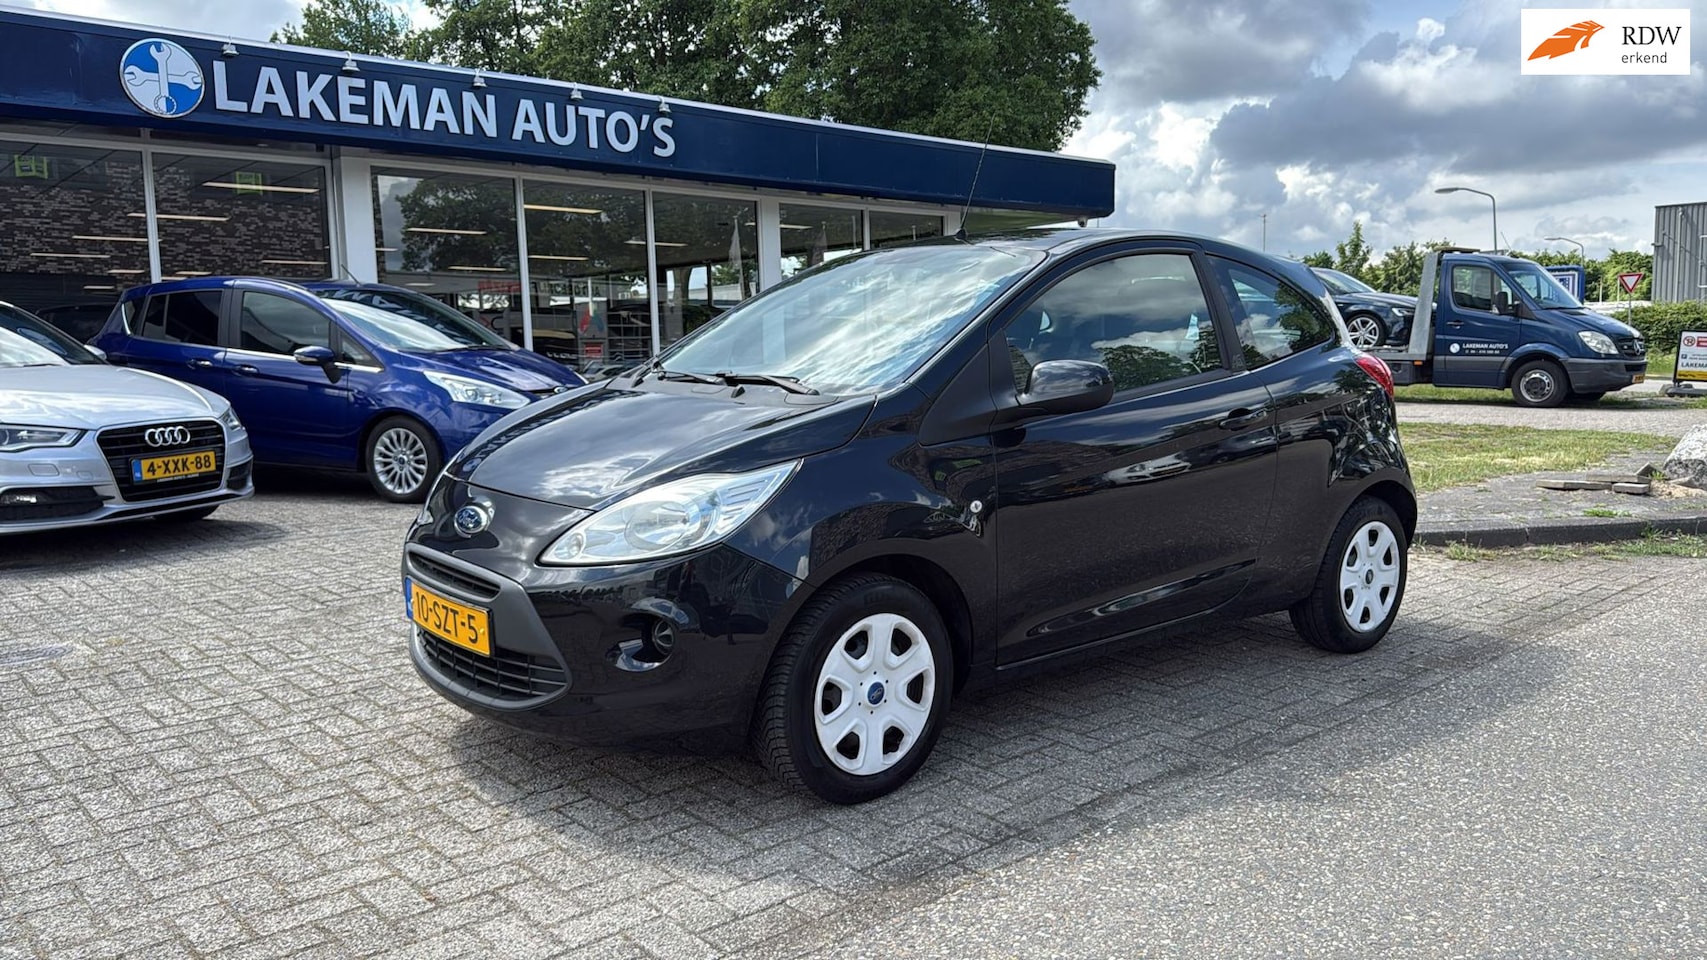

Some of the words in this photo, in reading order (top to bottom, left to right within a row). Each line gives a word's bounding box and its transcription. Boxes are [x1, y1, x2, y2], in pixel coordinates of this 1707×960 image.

[212, 60, 498, 138] LAKEMAN
[511, 98, 677, 158] AUTO'S
[146, 454, 212, 476] 4-XXK-88
[415, 591, 479, 644] 10-SZT-5
